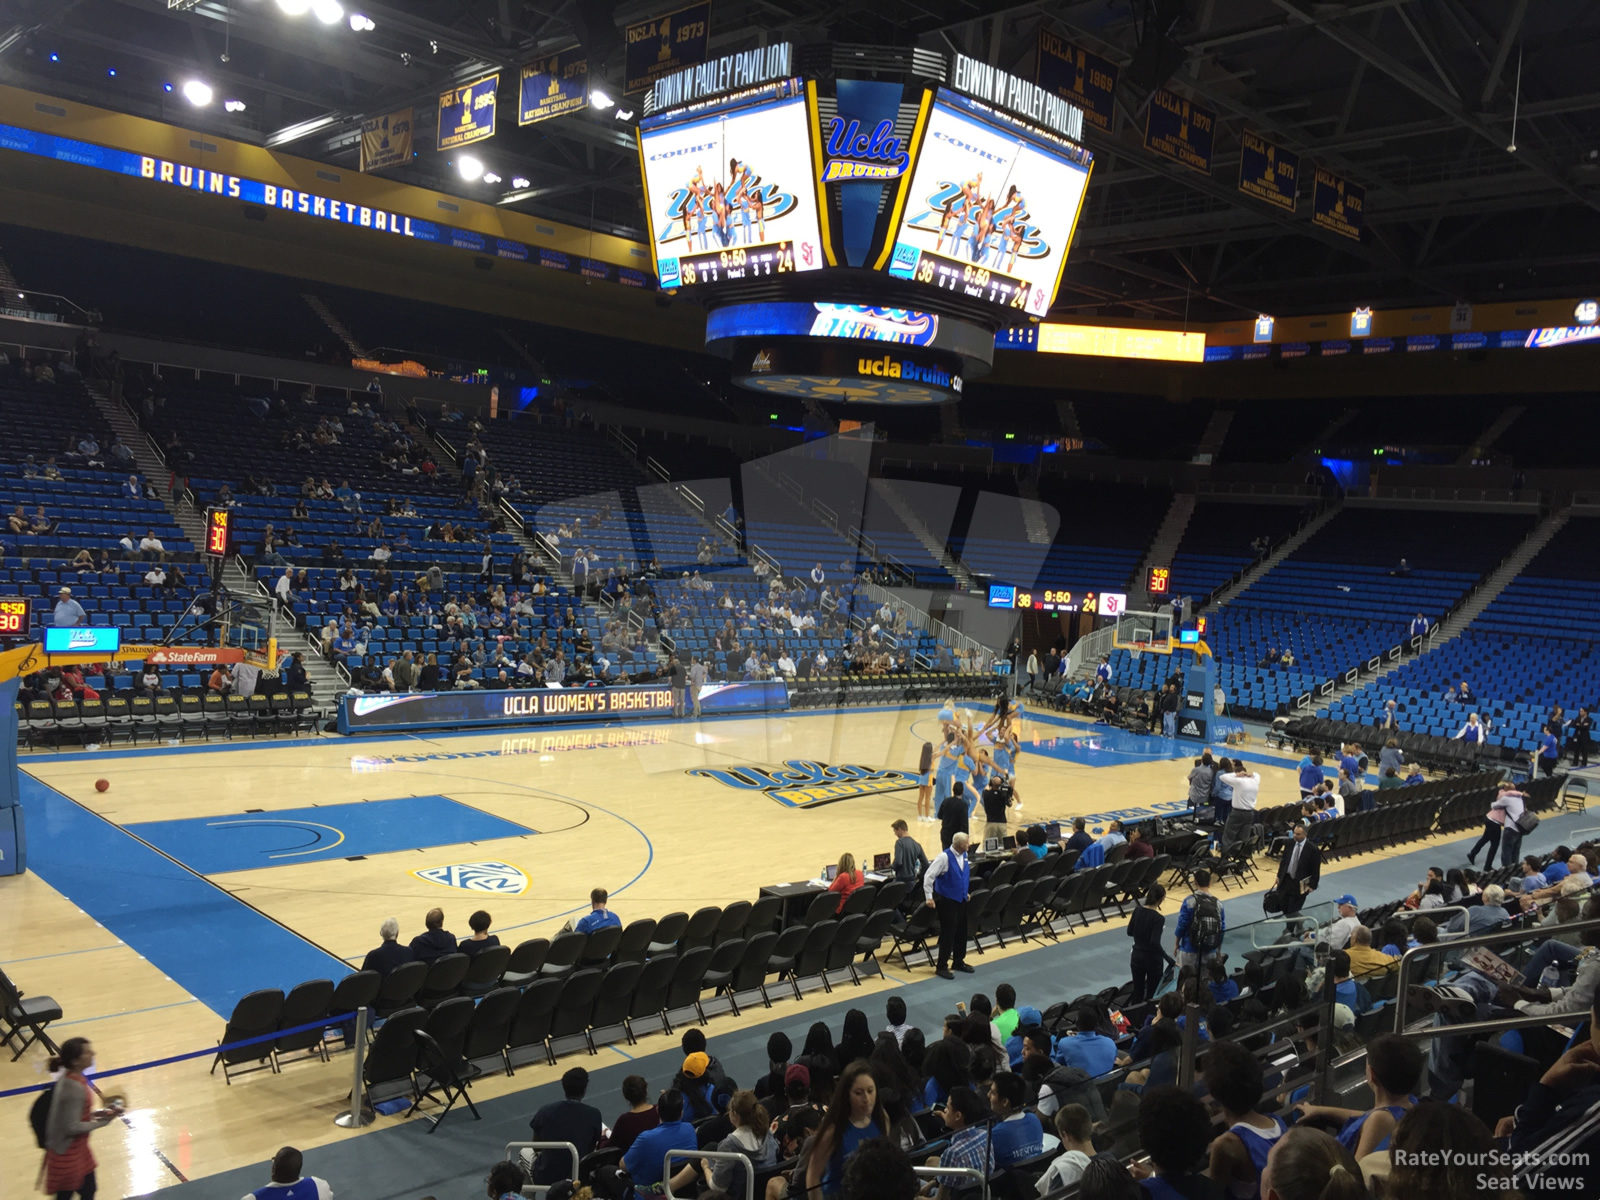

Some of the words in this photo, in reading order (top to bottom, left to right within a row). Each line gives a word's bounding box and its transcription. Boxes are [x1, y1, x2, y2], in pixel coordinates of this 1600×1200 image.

[628, 23, 656, 44] UCLA
[676, 21, 704, 43] 1973
[1042, 31, 1073, 64] UCLA
[523, 61, 546, 79] UCLA
[563, 58, 588, 79] 1975
[654, 70, 683, 110] EDWIN
[683, 66, 694, 101] W
[695, 55, 733, 97] PAULEY
[734, 42, 789, 87] PAVILION
[1089, 68, 1113, 93] 1969
[955, 53, 994, 101] EDWIN
[994, 68, 1008, 105] W
[1008, 74, 1046, 121] PAULEY
[1045, 92, 1084, 142] PAVILION
[1155, 90, 1181, 116] UCLA
[1193, 111, 1211, 133] 1970
[649, 141, 718, 162] COURT
[933, 131, 1008, 165] COURT
[1245, 134, 1265, 155] UCLA
[826, 162, 899, 180] BRUINS
[1277, 160, 1294, 180] 1971
[141, 156, 241, 198] BRUINS
[264, 184, 415, 236] BASKETBALL
[720, 249, 747, 268] 9:50
[765, 262, 771, 275] 3
[776, 250, 793, 273] 24
[682, 263, 697, 285] 36
[712, 269, 718, 281] 3
[917, 259, 935, 283] 36
[963, 265, 991, 288] 9:50
[1010, 287, 1028, 310] 24
[1574, 301, 1598, 321] 42
[214, 511, 228, 527] 9:50
[211, 526, 225, 551] 30
[1151, 576, 1165, 591] 30
[1153, 569, 1168, 578] 9:50
[1044, 590, 1071, 603] 9:50
[1082, 598, 1097, 613] 24
[0, 602, 26, 615] 9:50
[0, 615, 20, 631] 30
[121, 646, 157, 654] SPALDING
[503, 695, 538, 716] UCLA
[544, 692, 606, 714] WOMEN'S
[610, 690, 674, 711] BASKETBA
[1181, 728, 1200, 736] adidas
[775, 777, 918, 805] BRUINS
[417, 861, 523, 888] PAC
[472, 876, 521, 892] 12
